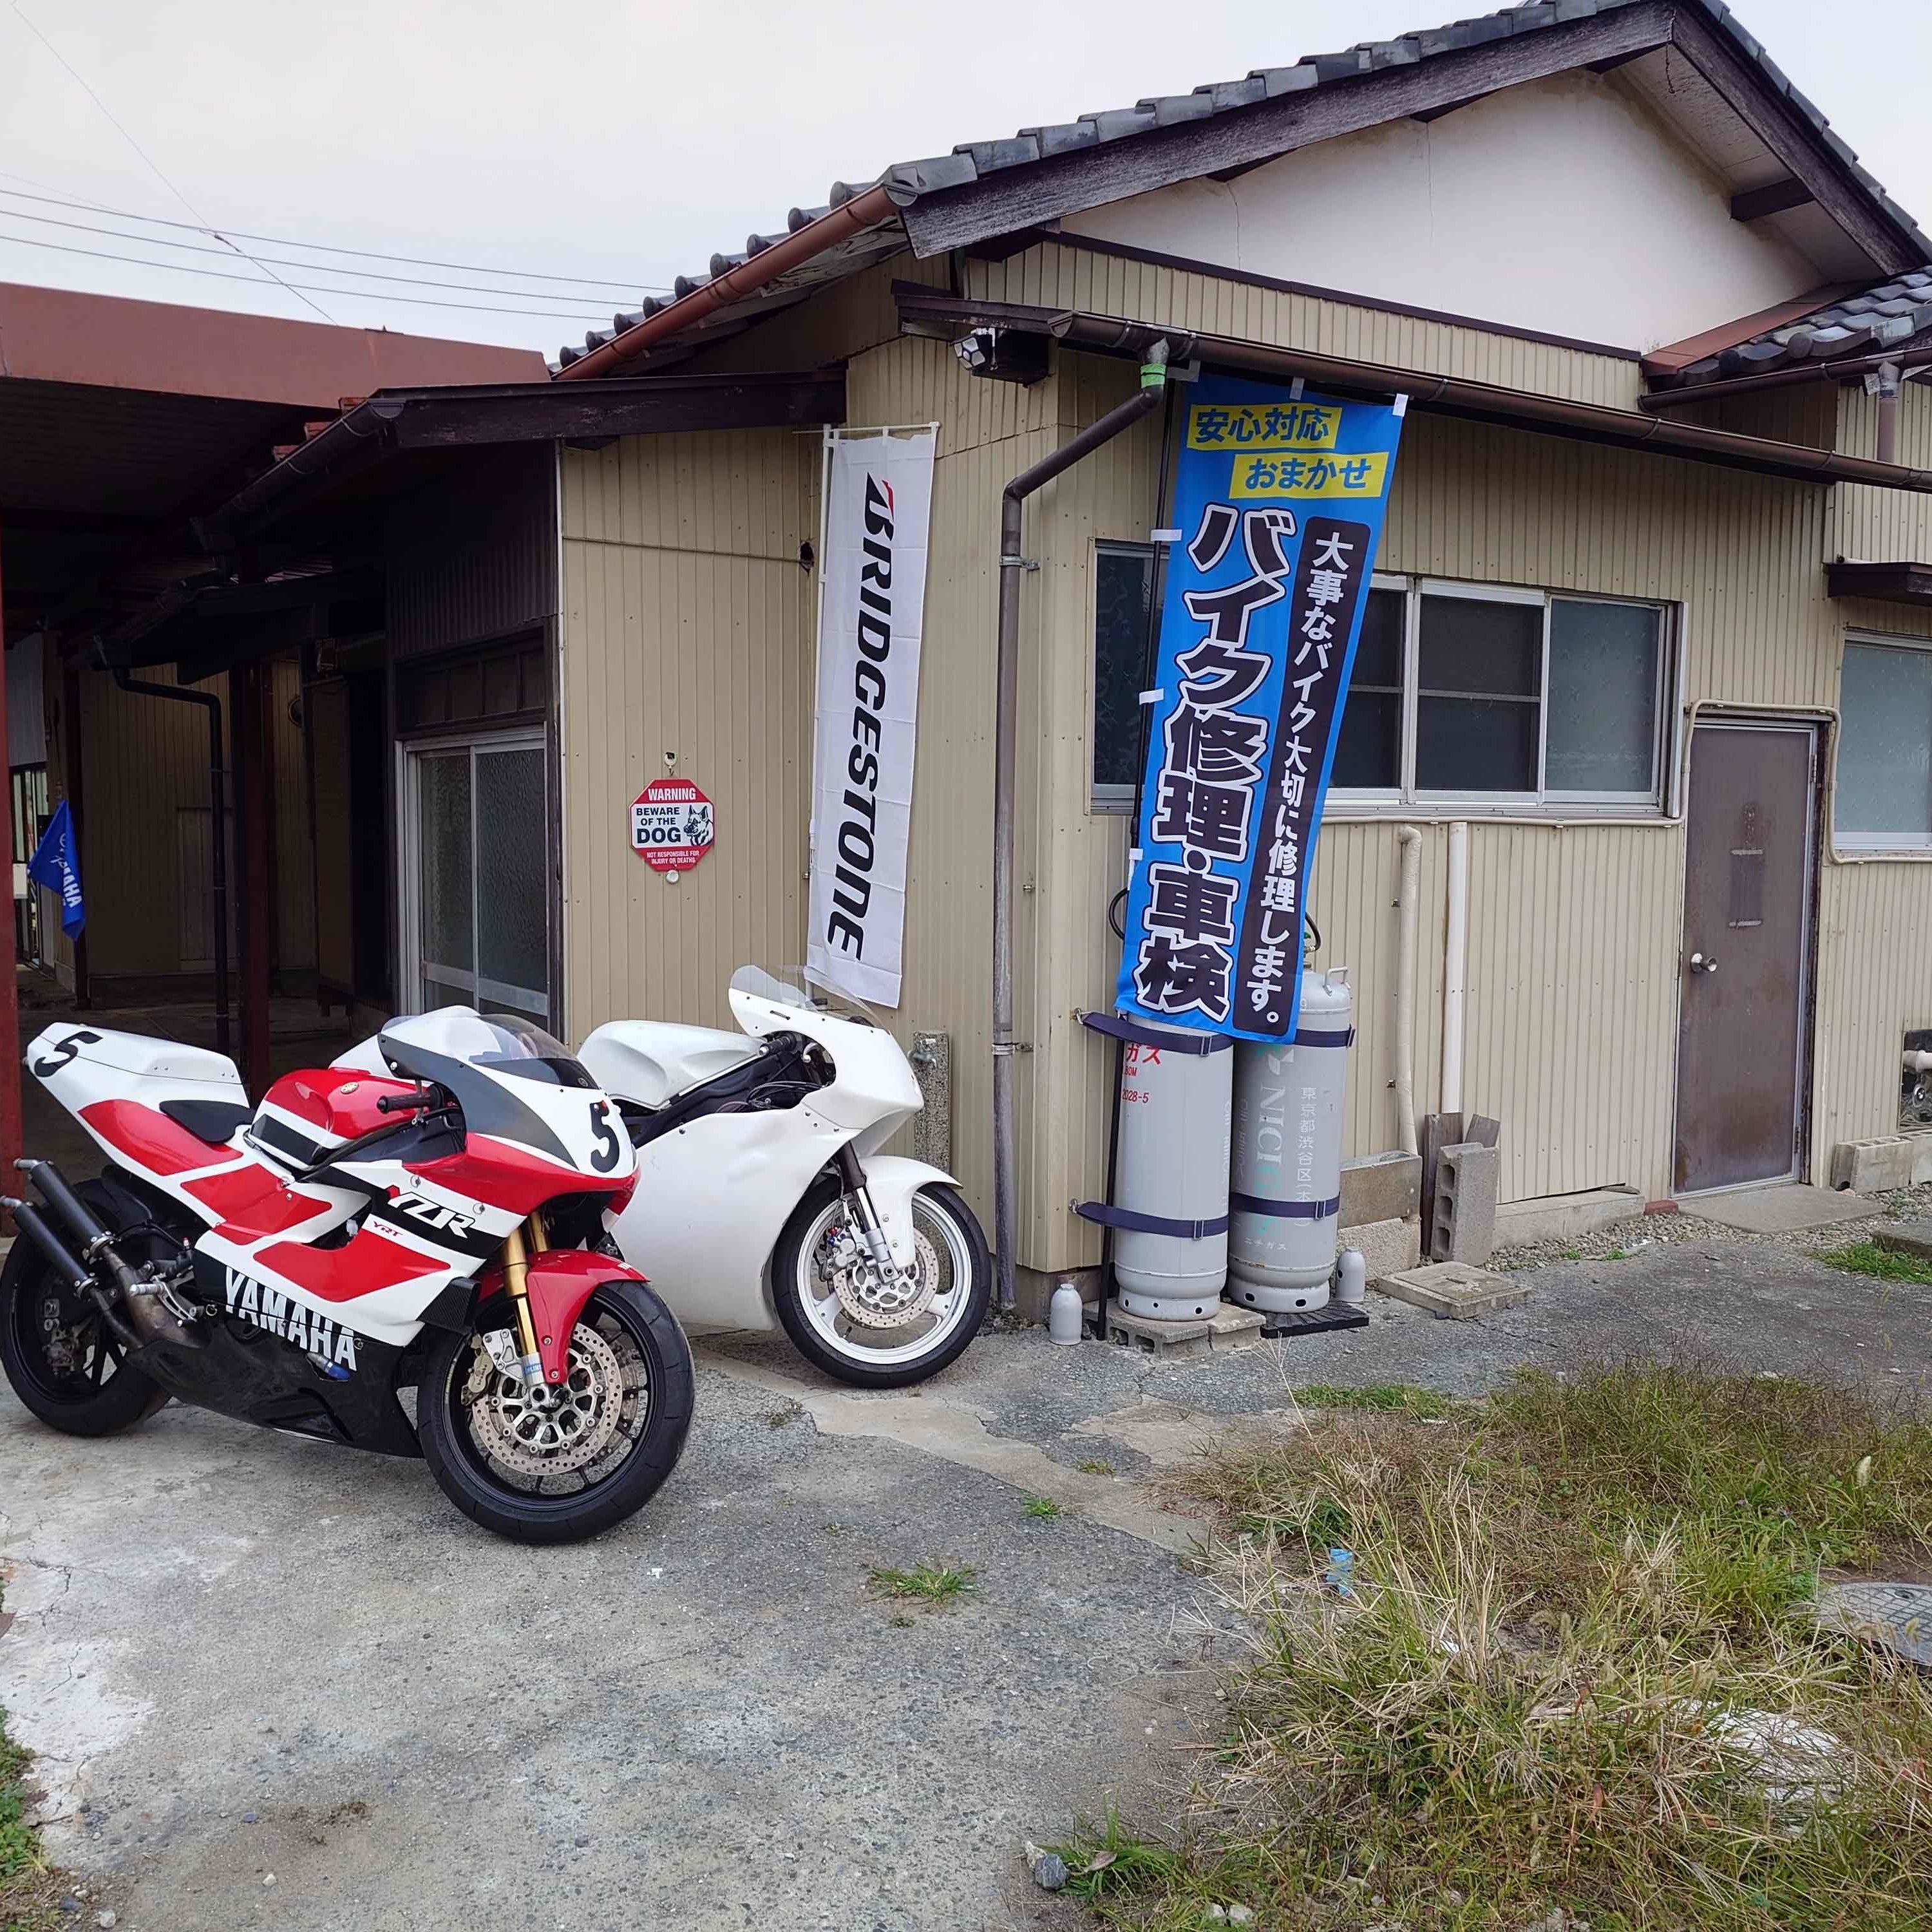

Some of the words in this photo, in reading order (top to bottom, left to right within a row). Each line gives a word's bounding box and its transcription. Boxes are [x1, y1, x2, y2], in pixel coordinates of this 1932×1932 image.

[1194, 406, 1332, 443] 安心対応
[1244, 457, 1372, 490] おまかせ
[827, 471, 895, 961] BRIDGESTONE
[1133, 502, 1296, 1023] バイク修理・車検
[1246, 531, 1354, 1024] 大事なバイク大切に修理します。
[636, 807, 680, 816] BEWARE
[648, 788, 696, 801] WARNING
[636, 827, 681, 844] DOG
[34, 1030, 104, 1078] 5
[589, 1099, 620, 1173] 5
[373, 1220, 403, 1237] YRT
[386, 1184, 476, 1239] YZR
[225, 1265, 357, 1372] YAMAHA
